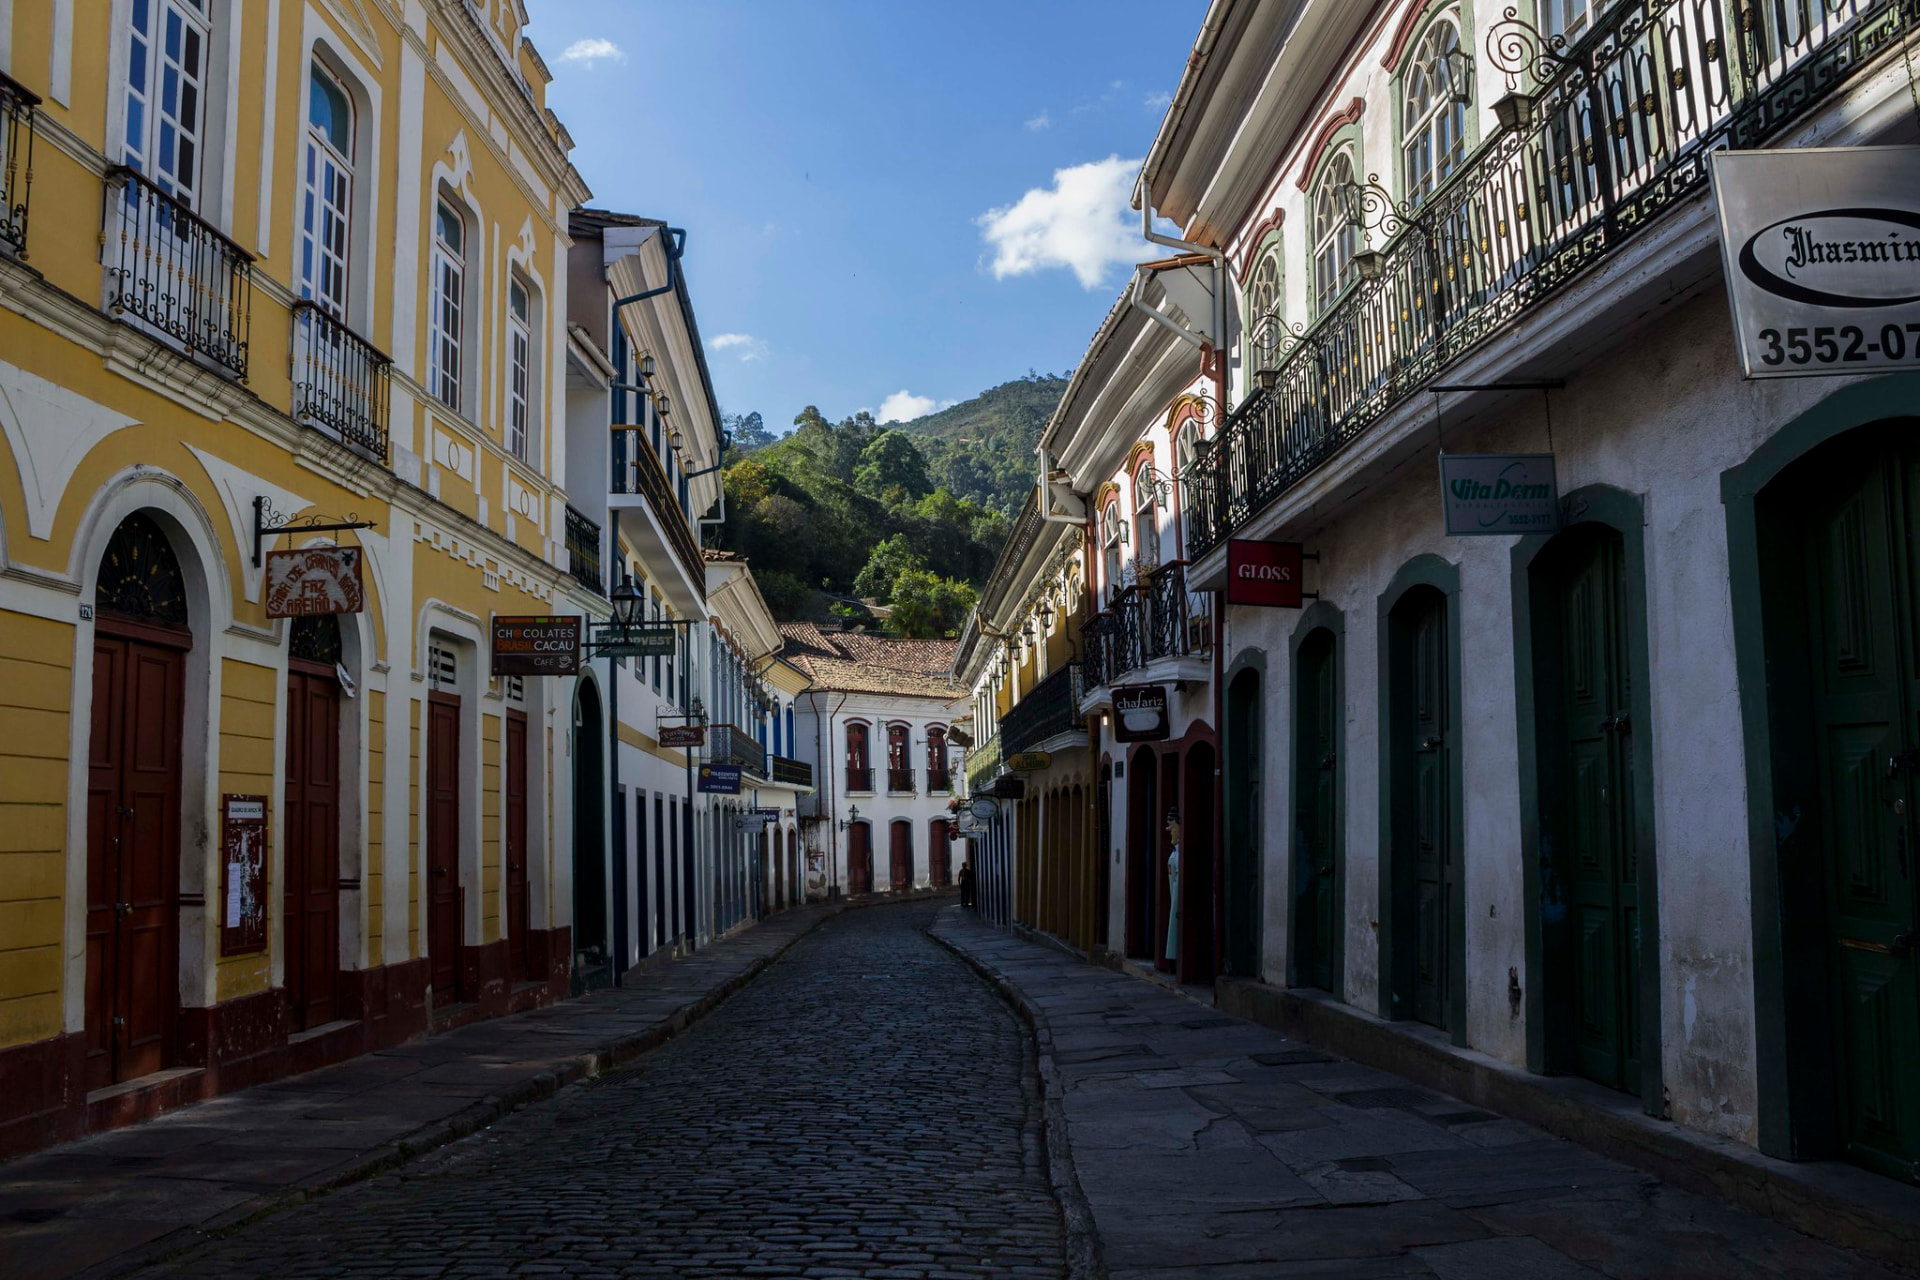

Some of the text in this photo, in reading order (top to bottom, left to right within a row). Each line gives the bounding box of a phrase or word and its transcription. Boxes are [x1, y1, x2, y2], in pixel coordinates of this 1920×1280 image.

[1238, 564, 1290, 581] GLOSS
[497, 628, 575, 638] CHOCOLATES
[534, 641, 574, 651] CACAU
[1116, 690, 1164, 709] chafariz
